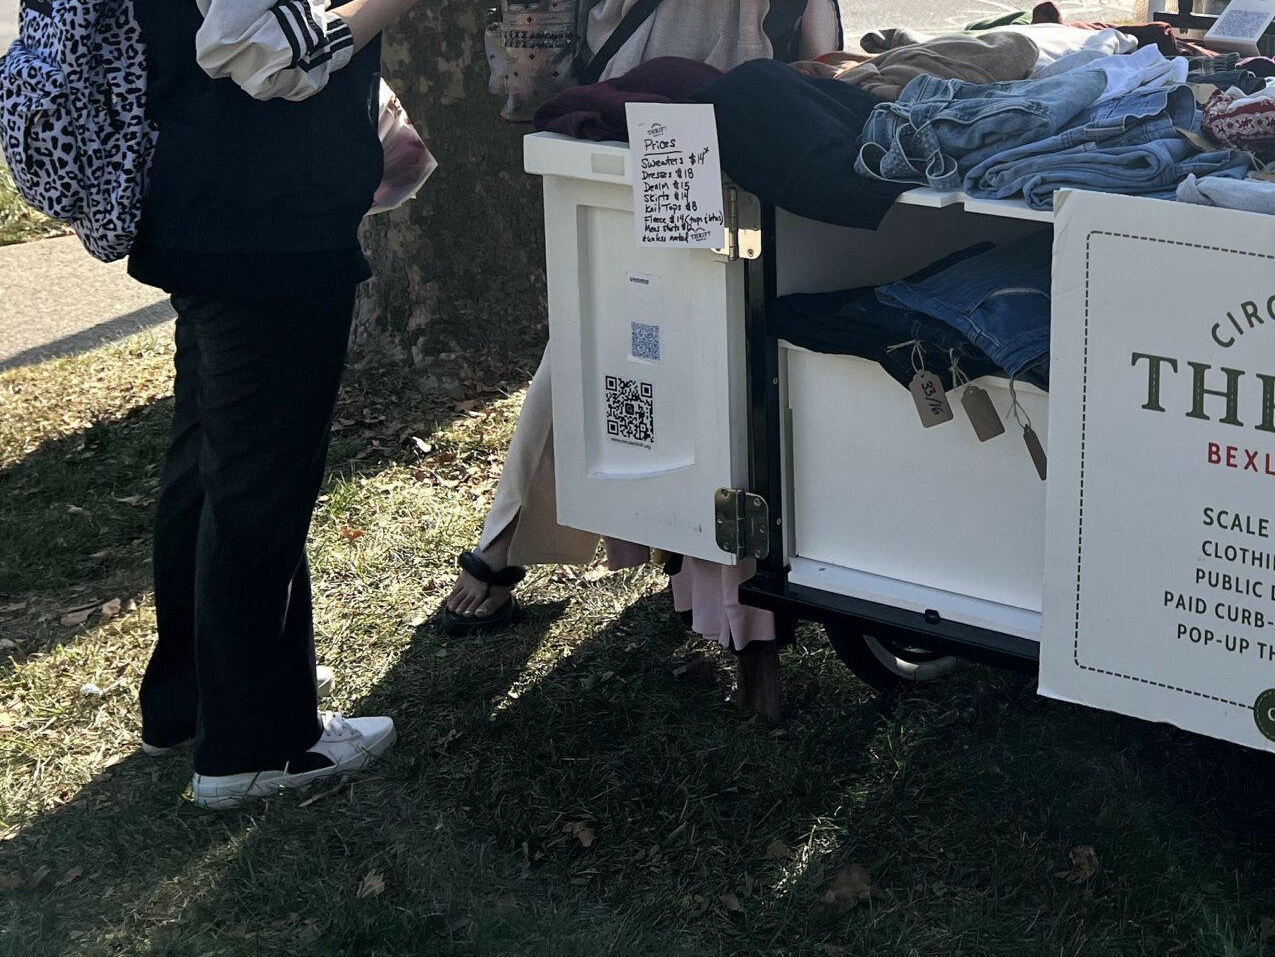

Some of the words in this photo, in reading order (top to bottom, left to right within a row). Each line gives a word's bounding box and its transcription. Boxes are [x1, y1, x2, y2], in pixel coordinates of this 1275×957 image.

[644, 138, 676, 150] Prices
[641, 156, 684, 169] Sweaters
[642, 170, 672, 180] Dresses
[676, 168, 694, 179] $18
[673, 180, 690, 190] $15
[644, 191, 670, 202] Skirts
[674, 190, 689, 203] $14
[645, 201, 661, 213] Knit
[661, 202, 682, 214] Tops
[686, 200, 698, 212] $8
[644, 216, 666, 224] Fleece
[670, 214, 684, 224] $14
[1203, 507, 1269, 538] SCALE
[1196, 568, 1262, 598] PUBLIC
[1164, 591, 1206, 614] PAID
[1178, 624, 1249, 654] POP-UP
